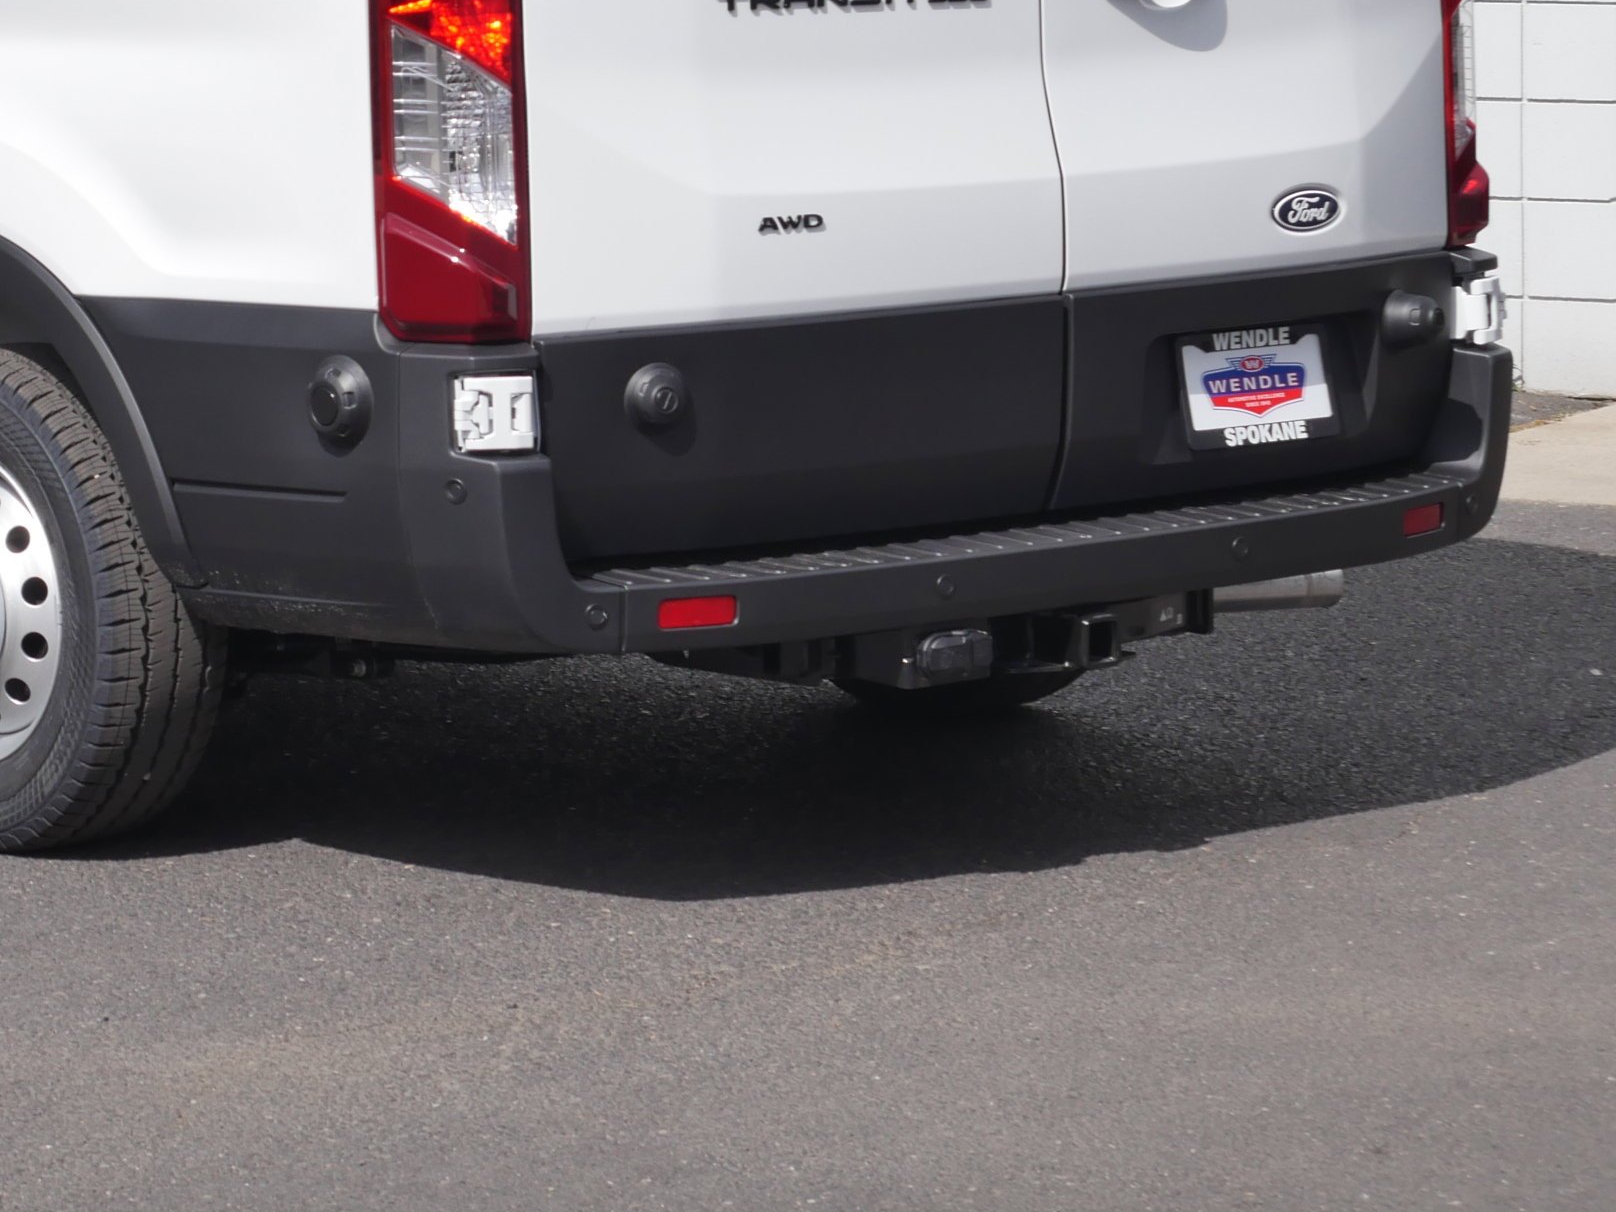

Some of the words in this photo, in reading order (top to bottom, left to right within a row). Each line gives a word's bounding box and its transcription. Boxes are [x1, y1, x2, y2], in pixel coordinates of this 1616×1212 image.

[1287, 196, 1329, 224] Ford
[758, 213, 824, 233] AWD
[1212, 327, 1291, 351] WENDLE
[1209, 372, 1300, 394] WENDLE
[1223, 420, 1309, 447] SPOKANE
